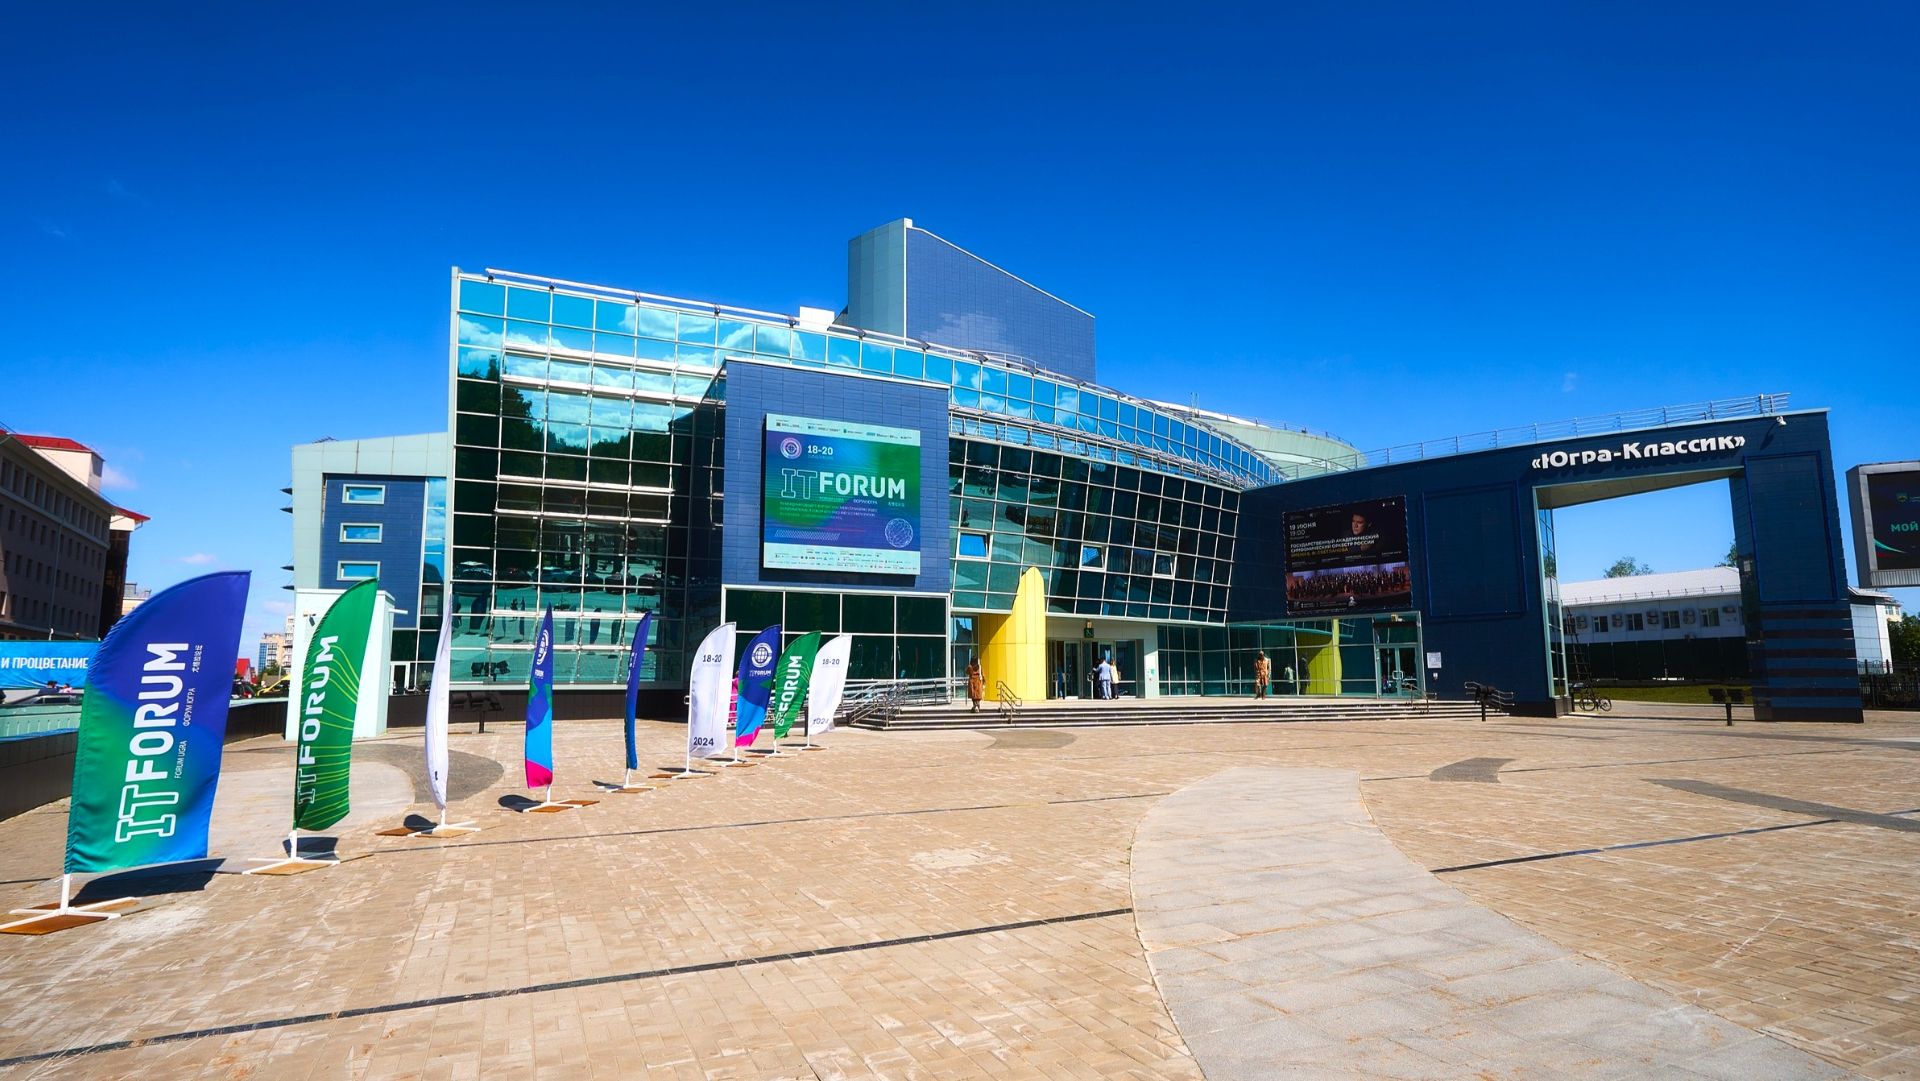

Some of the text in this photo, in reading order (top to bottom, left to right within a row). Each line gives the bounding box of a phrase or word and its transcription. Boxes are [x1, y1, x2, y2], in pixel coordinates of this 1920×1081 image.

[807, 444, 834, 455] 18-20
[1531, 435, 1746, 469] «Югра-Классик»
[1890, 521, 1919, 533] МОЙ
[1, 657, 89, 670] И ПРОЦВЕТАНИЕ
[702, 654, 722, 663] 18-20
[182, 704, 193, 727] ФОРУМ
[693, 736, 715, 747] 2024
[174, 740, 188, 779] FORUM UGRA
